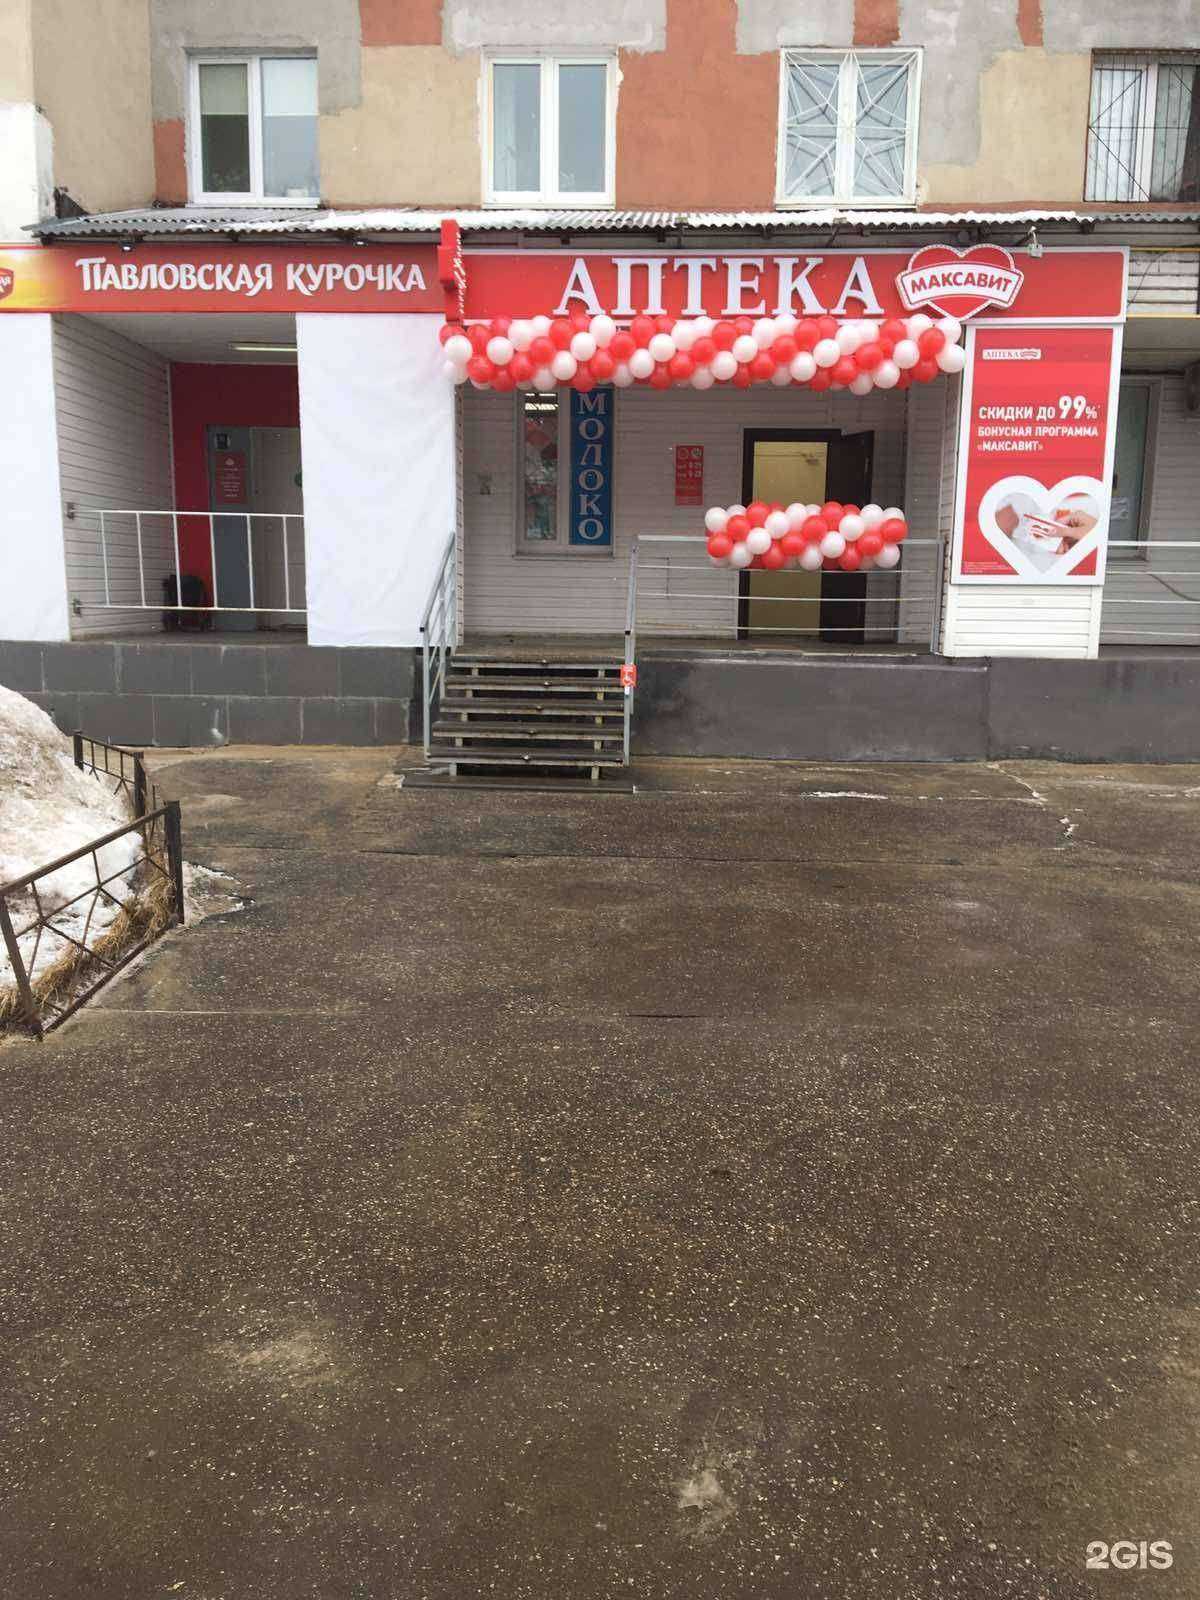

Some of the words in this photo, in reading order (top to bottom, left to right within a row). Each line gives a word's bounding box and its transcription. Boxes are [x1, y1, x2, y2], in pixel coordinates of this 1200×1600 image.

[75, 257, 273, 296] ПАВЛОВСКАЯ
[286, 263, 426, 296] КУРОЧКА
[553, 257, 885, 316] АПТЕКА
[911, 271, 1013, 294] МАКСАВИТ
[978, 406, 1033, 421] СКИДКИ
[1036, 406, 1056, 421] ДО
[977, 426, 1032, 437] БОНУСНАЯ
[1035, 426, 1098, 437] ПРОГРАММА
[977, 440, 1043, 452] «МАКСАВИТ»
[577, 392, 606, 540] МОЛОКО
